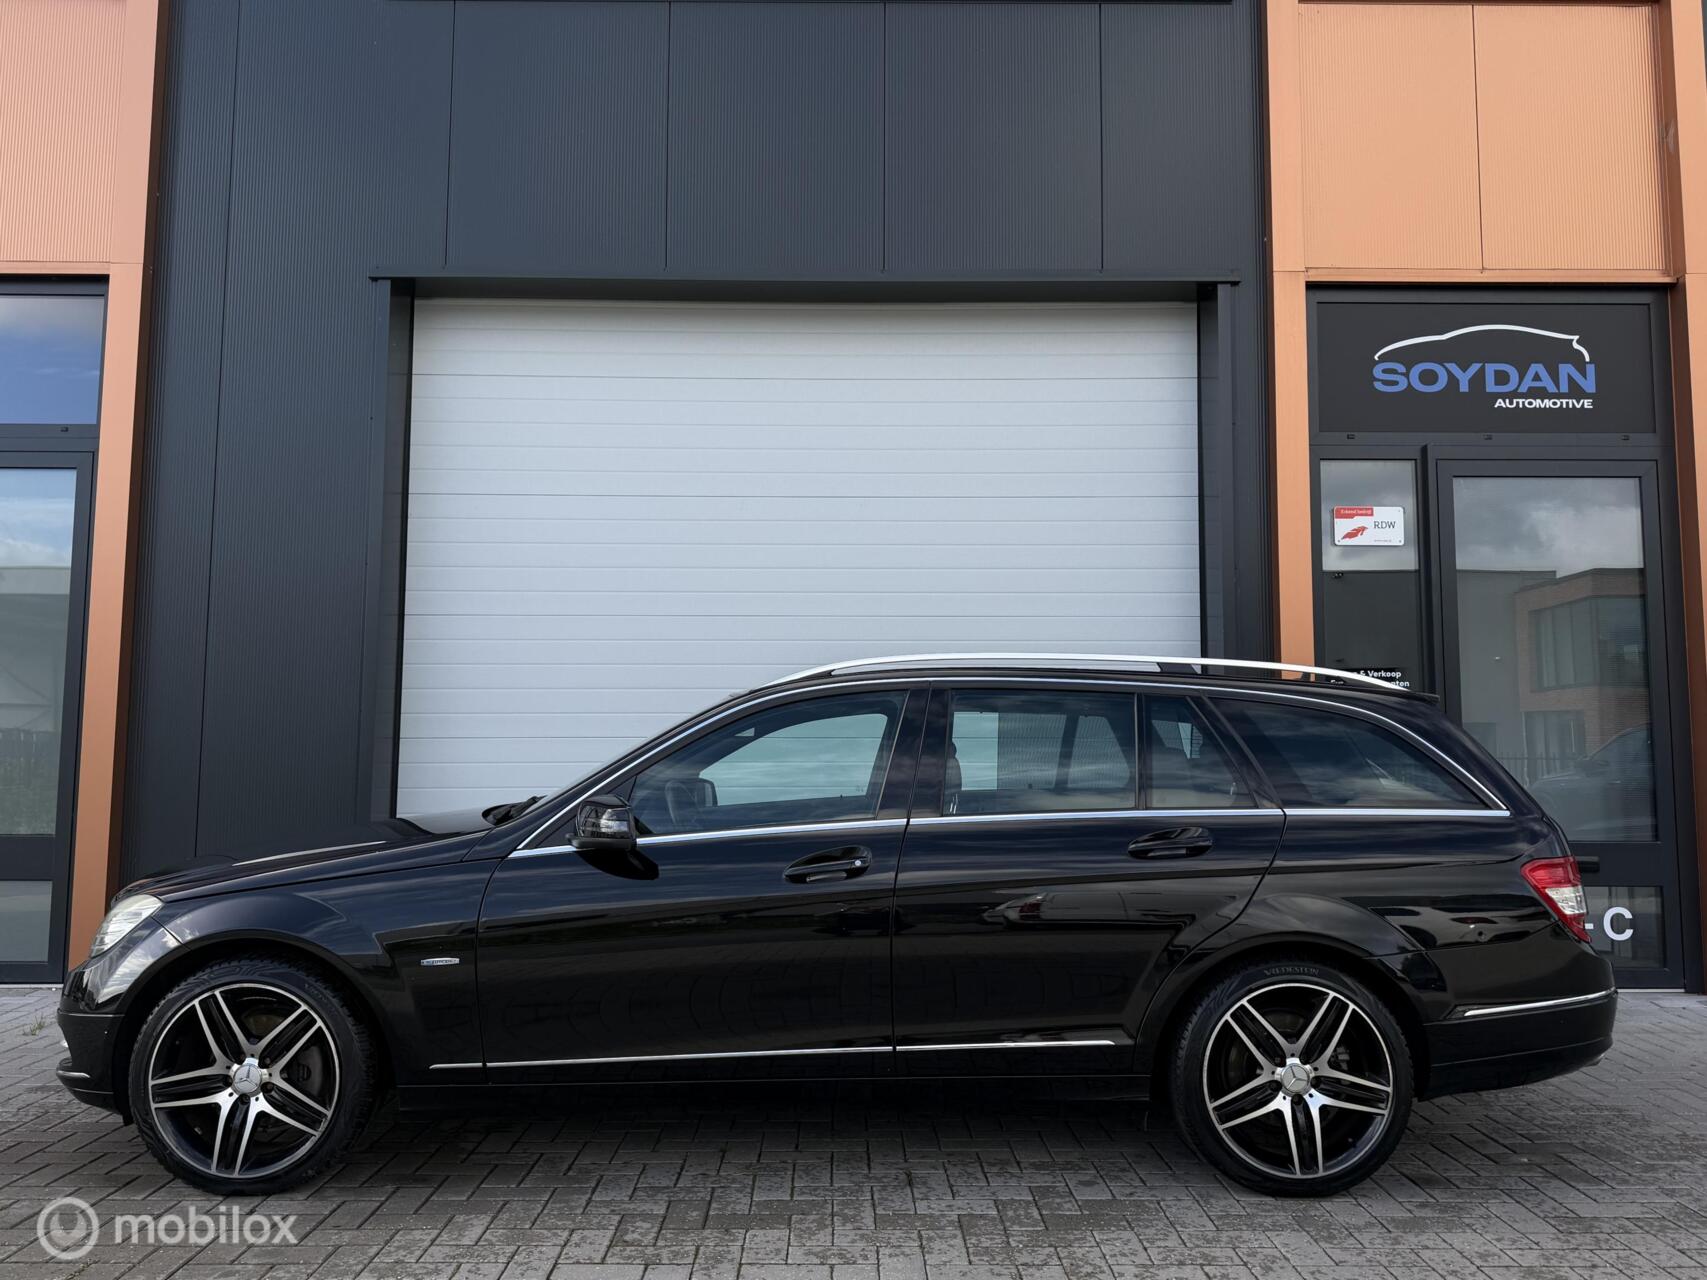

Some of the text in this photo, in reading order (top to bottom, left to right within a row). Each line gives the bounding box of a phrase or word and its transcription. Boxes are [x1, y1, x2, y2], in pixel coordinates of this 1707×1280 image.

[1372, 361, 1597, 393] SOYDAN
[1494, 398, 1593, 409] AUTOMOTIVE
[1373, 520, 1396, 529] RDW
[1368, 670, 1401, 678] Verkoop
